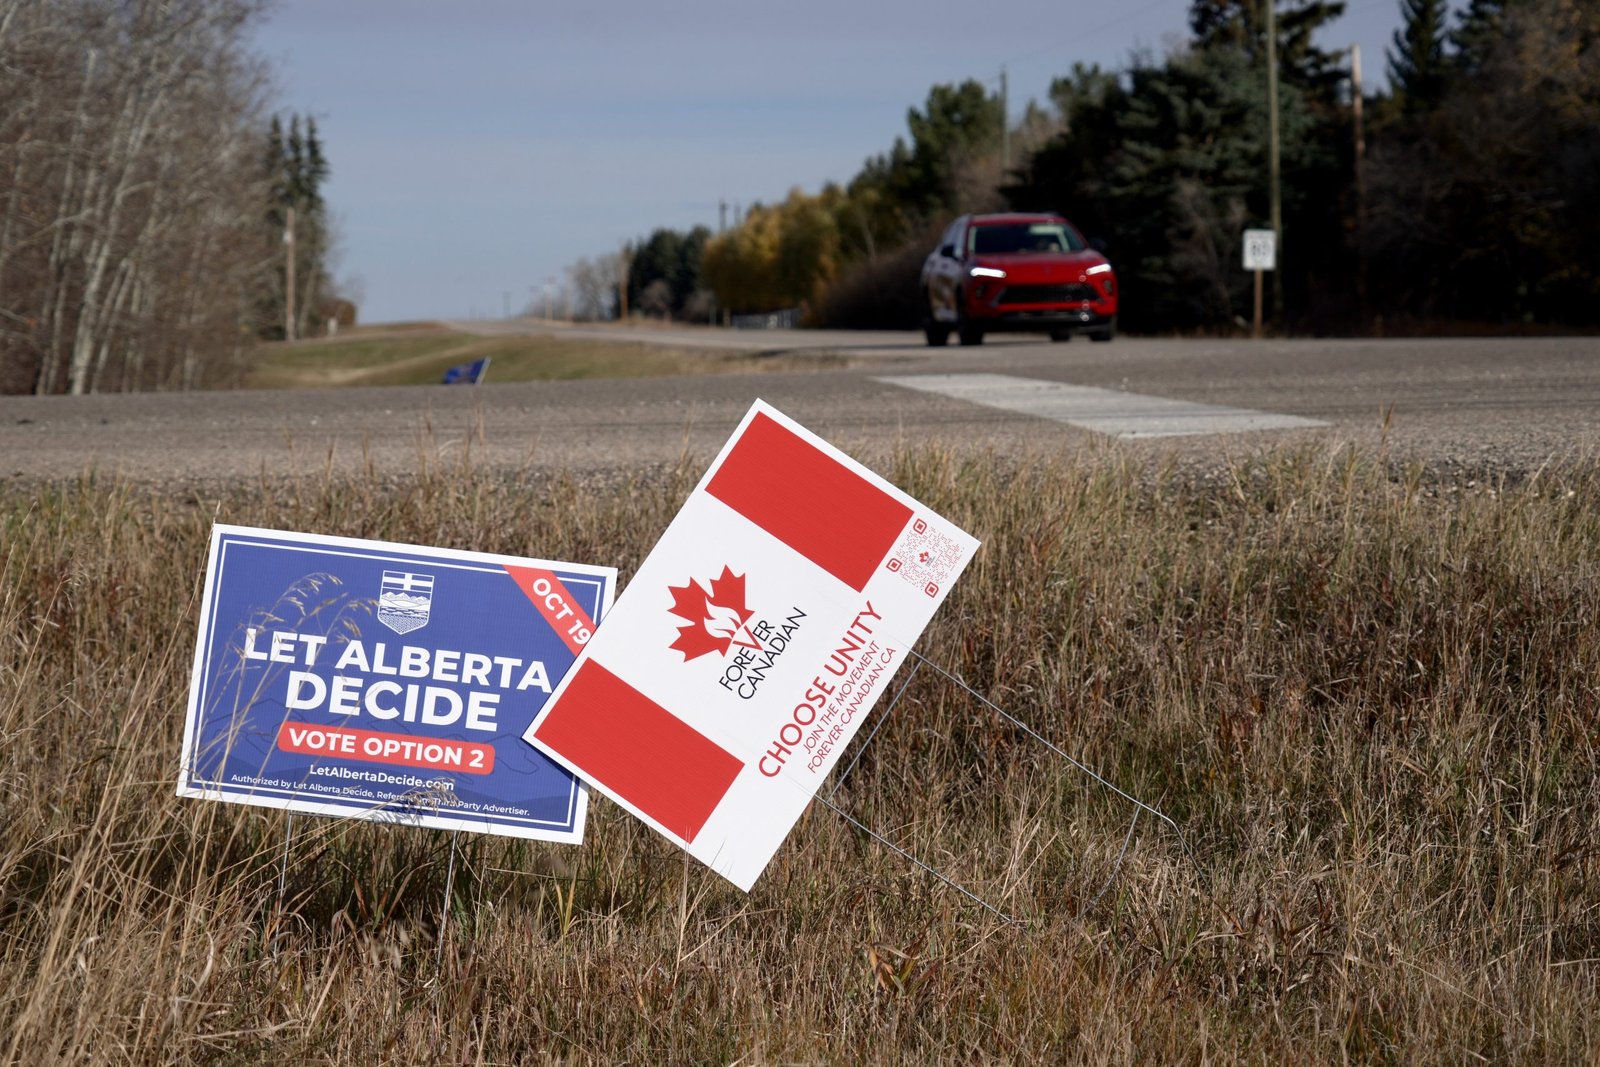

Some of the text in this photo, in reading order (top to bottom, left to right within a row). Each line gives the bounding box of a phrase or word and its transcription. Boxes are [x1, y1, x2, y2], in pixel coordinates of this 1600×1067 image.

[533, 578, 591, 645] OCT 19
[244, 628, 552, 694] LET ALBERTA
[719, 620, 775, 691] FOREVER
[738, 607, 807, 699] CANADIAN
[285, 670, 500, 732] DECIDE
[758, 600, 882, 777] CHOOSE UNITY
[803, 640, 880, 754] JOIN THE MOVEMENT
[807, 647, 896, 774] FOREVER-CANADIAN.CA
[288, 728, 485, 768] VOTE OPTION 2
[310, 764, 455, 791] LetAlbertaDecide.com
[231, 774, 279, 787] Authorized
[281, 780, 292, 789] by
[308, 783, 341, 794] Alberta
[343, 787, 375, 799] Decide,
[458, 800, 481, 811] Party
[482, 804, 530, 817] Advertiser.
